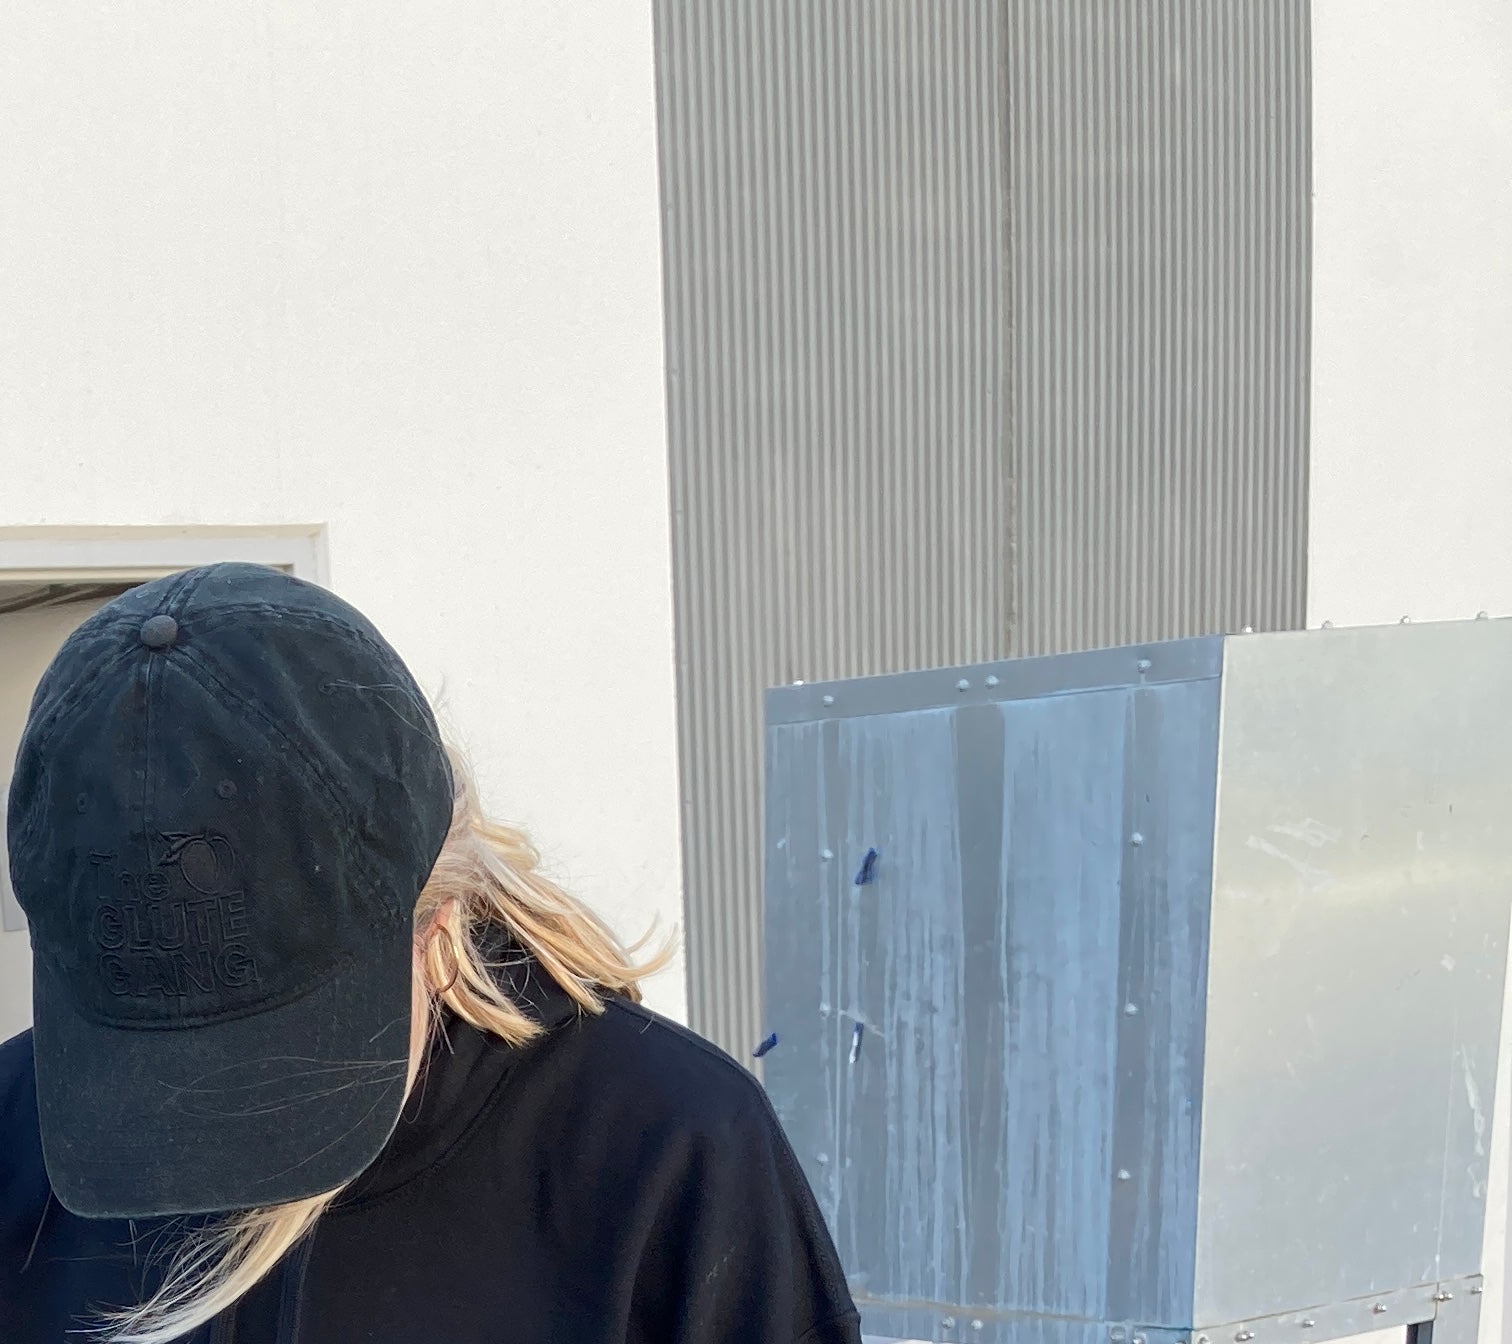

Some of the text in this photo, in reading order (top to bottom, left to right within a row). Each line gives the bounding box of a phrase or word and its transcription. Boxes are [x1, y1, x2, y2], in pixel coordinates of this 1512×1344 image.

[89, 848, 171, 901] The
[92, 890, 251, 951] GLUTE
[99, 942, 262, 997] GANG
